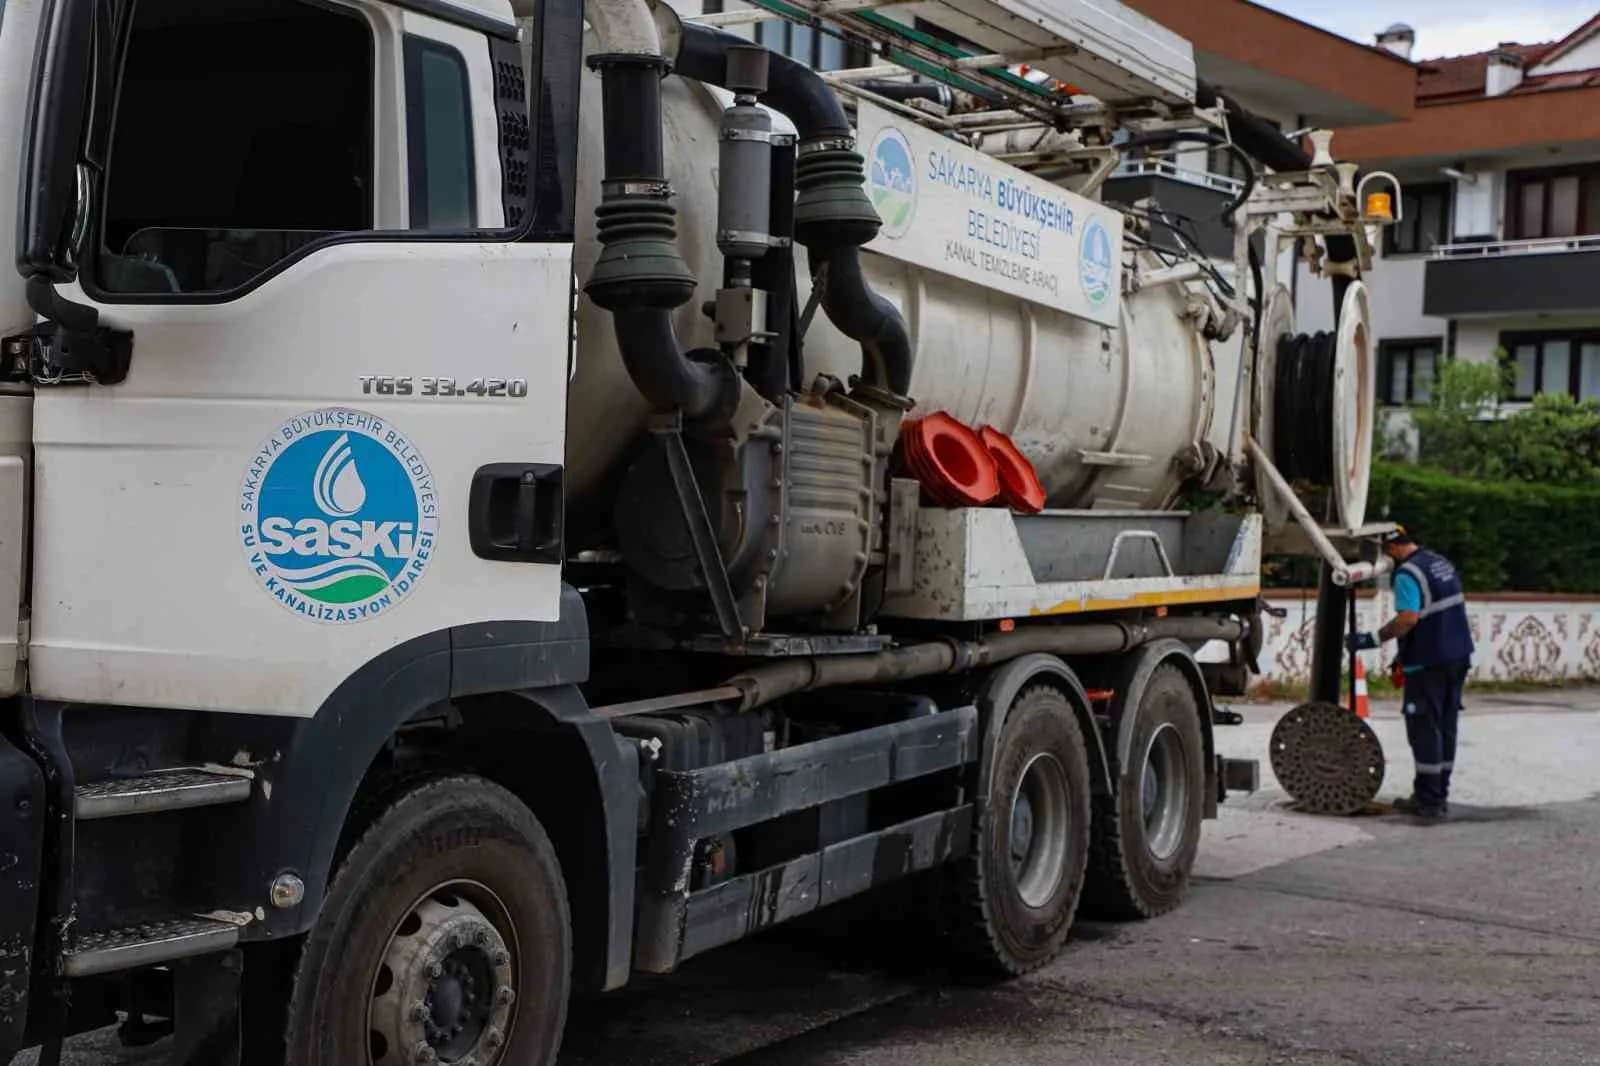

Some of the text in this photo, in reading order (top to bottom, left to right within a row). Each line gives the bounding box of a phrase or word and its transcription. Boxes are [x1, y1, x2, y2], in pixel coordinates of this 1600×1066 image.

[928, 151, 1074, 236] SAKARYA BÜYÜKŞEHİR
[945, 239, 978, 267] KANAL
[968, 208, 1040, 261] BELEDİYESİ
[359, 376, 528, 398] TGS 33.420
[241, 411, 436, 520] SAKARYA BÜYÜKŞEHİR BELEDİYESİ
[241, 523, 434, 622] SU VE KANALİZASYON İDARESİ
